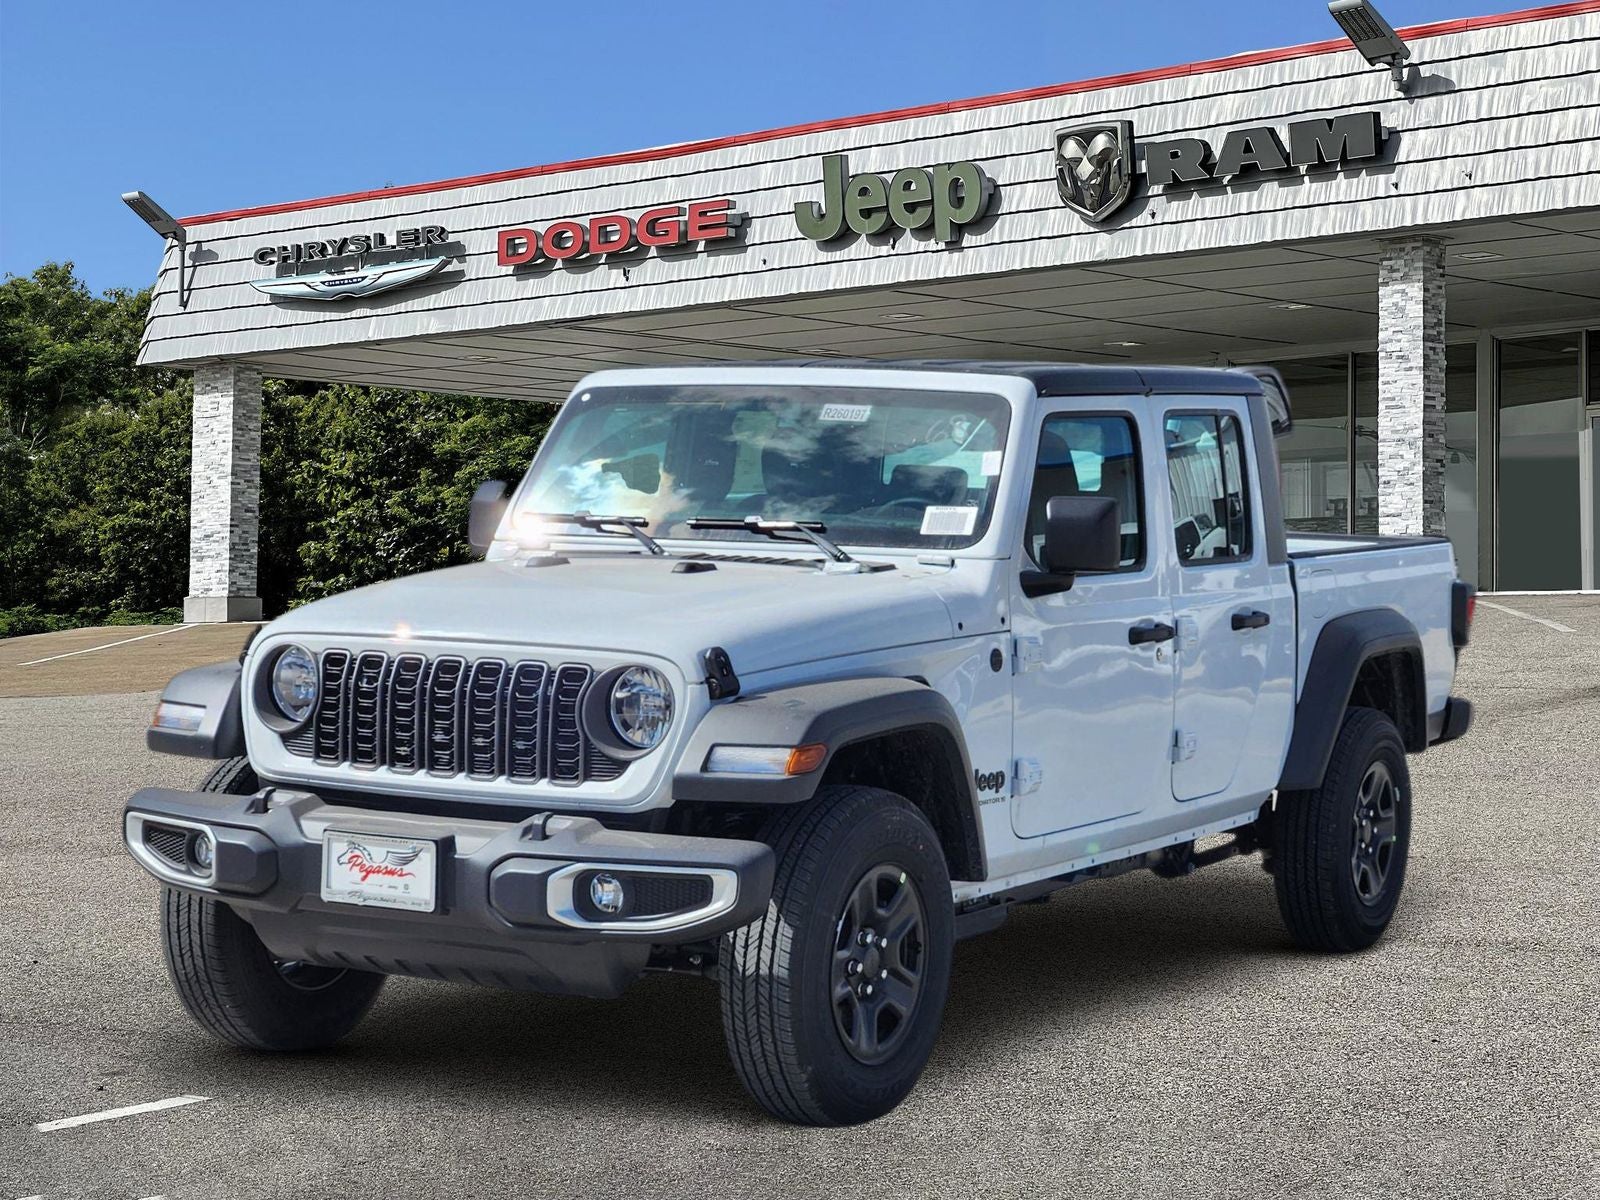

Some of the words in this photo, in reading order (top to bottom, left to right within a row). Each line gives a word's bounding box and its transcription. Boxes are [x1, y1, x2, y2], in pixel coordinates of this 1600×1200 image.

[1145, 111, 1381, 186] RAM
[795, 154, 988, 242] Jeep
[253, 225, 448, 266] CHRYSLER
[498, 199, 737, 266] DODGE
[324, 277, 363, 286] CHRYSLER
[823, 407, 866, 420] R260197
[347, 854, 416, 881] Pegasus
